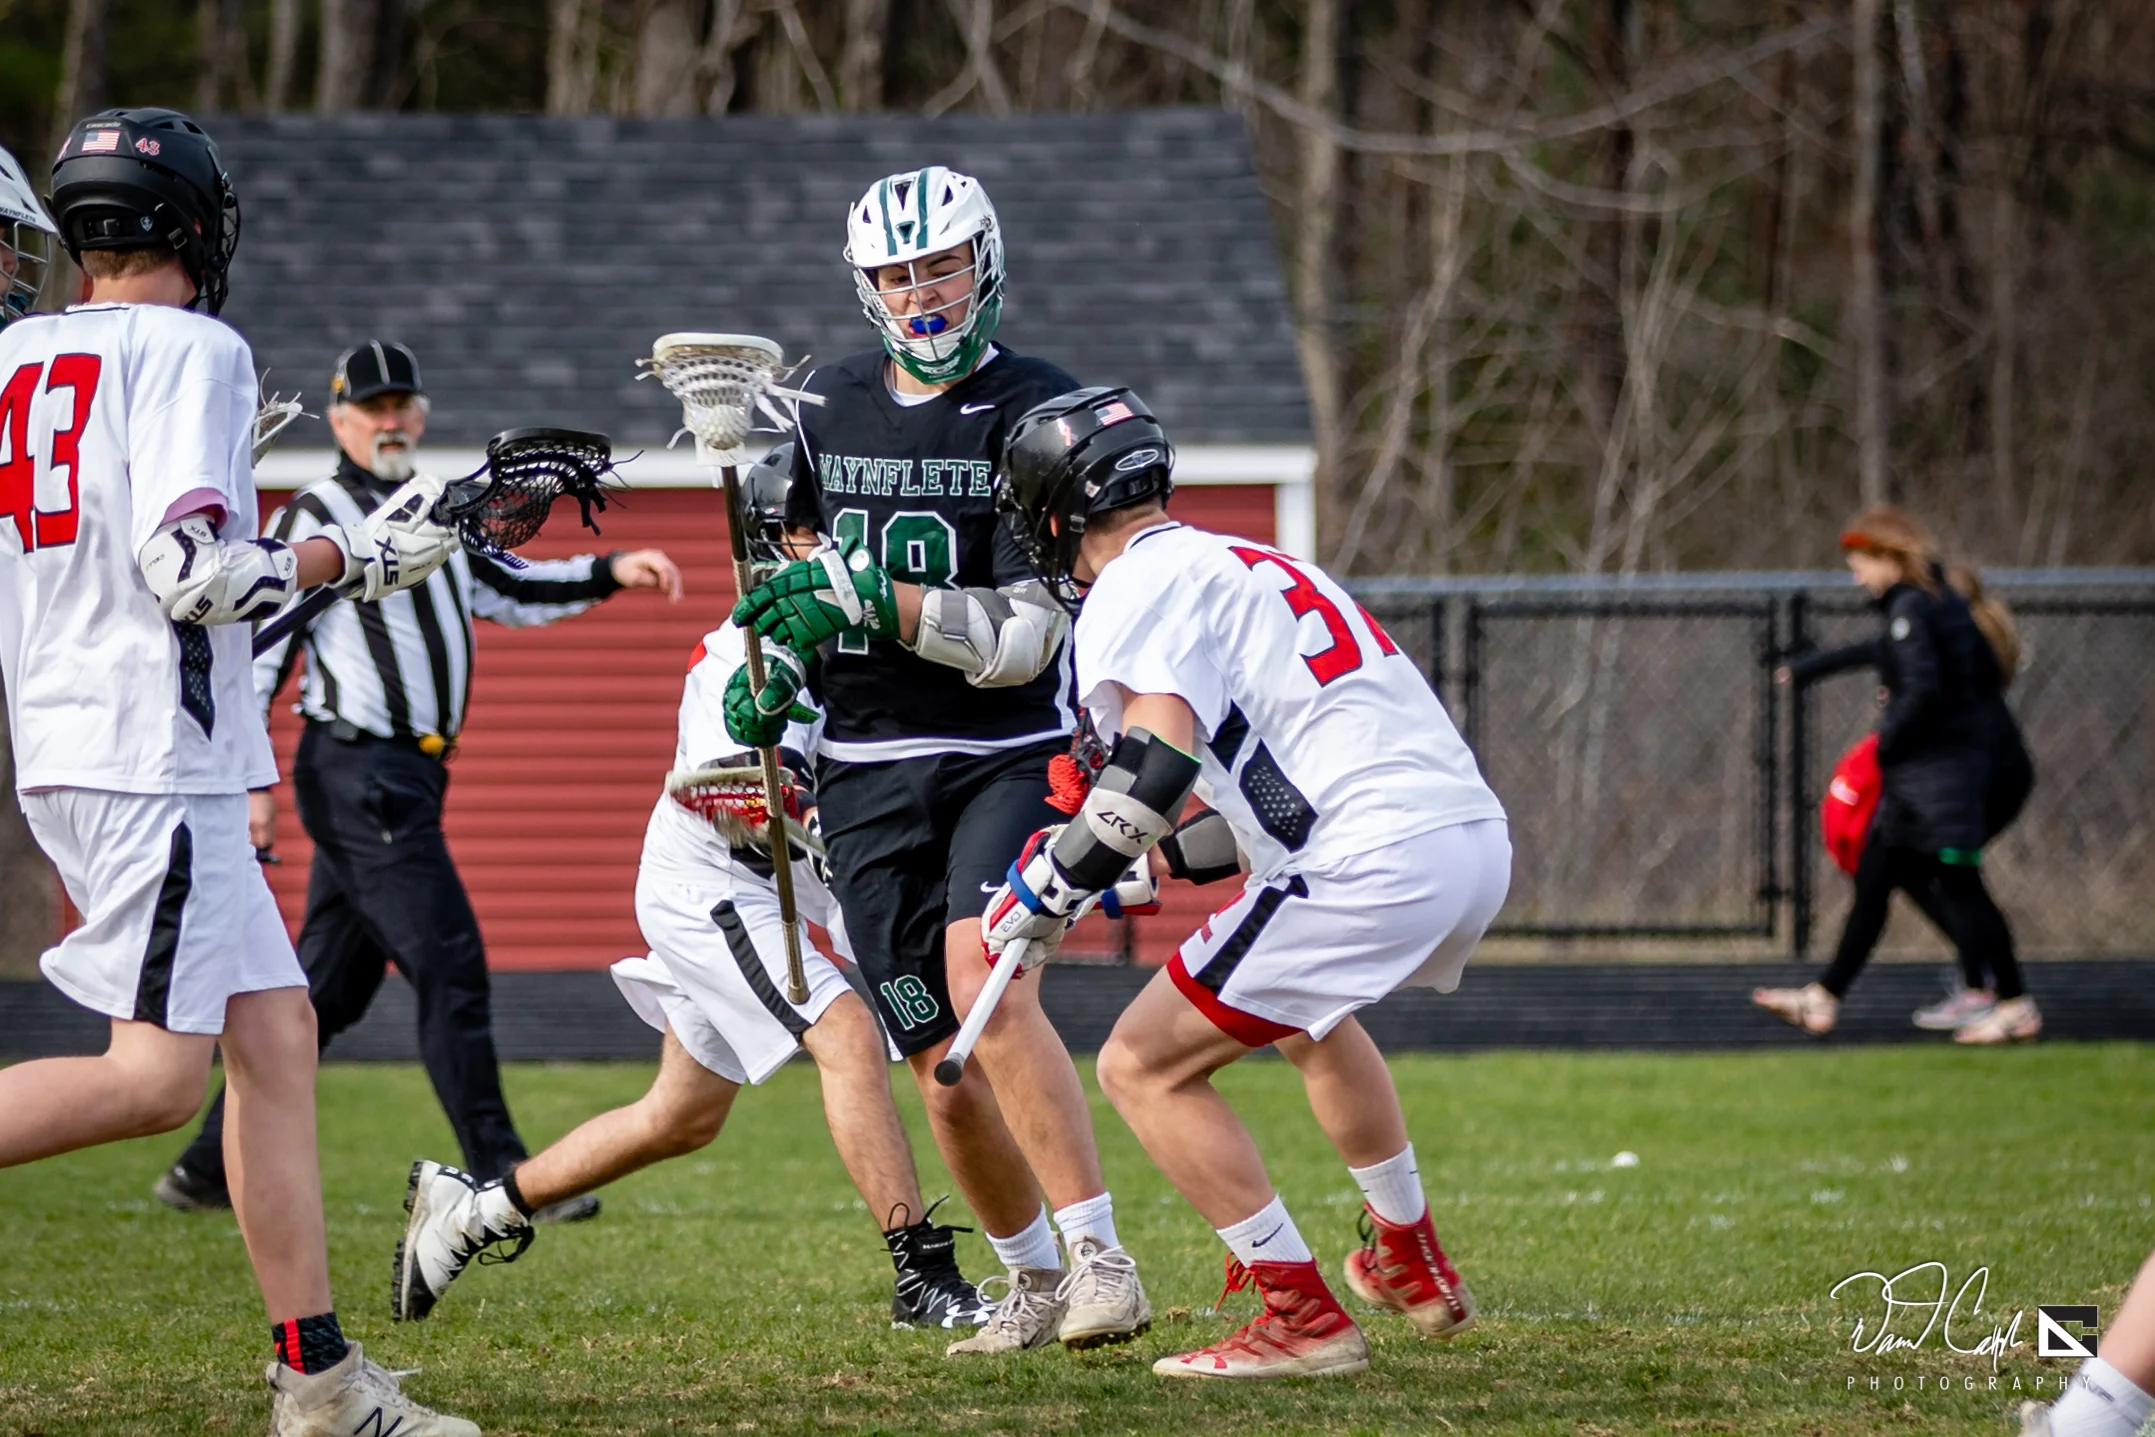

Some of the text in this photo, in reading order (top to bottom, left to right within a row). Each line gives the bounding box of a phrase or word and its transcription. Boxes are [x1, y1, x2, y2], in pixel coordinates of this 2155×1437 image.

[135, 137, 160, 156] 43
[0, 352, 102, 554] 43
[818, 453, 992, 497] WAYNFLETE
[374, 536, 399, 586] STX
[880, 974, 939, 1031] 18
